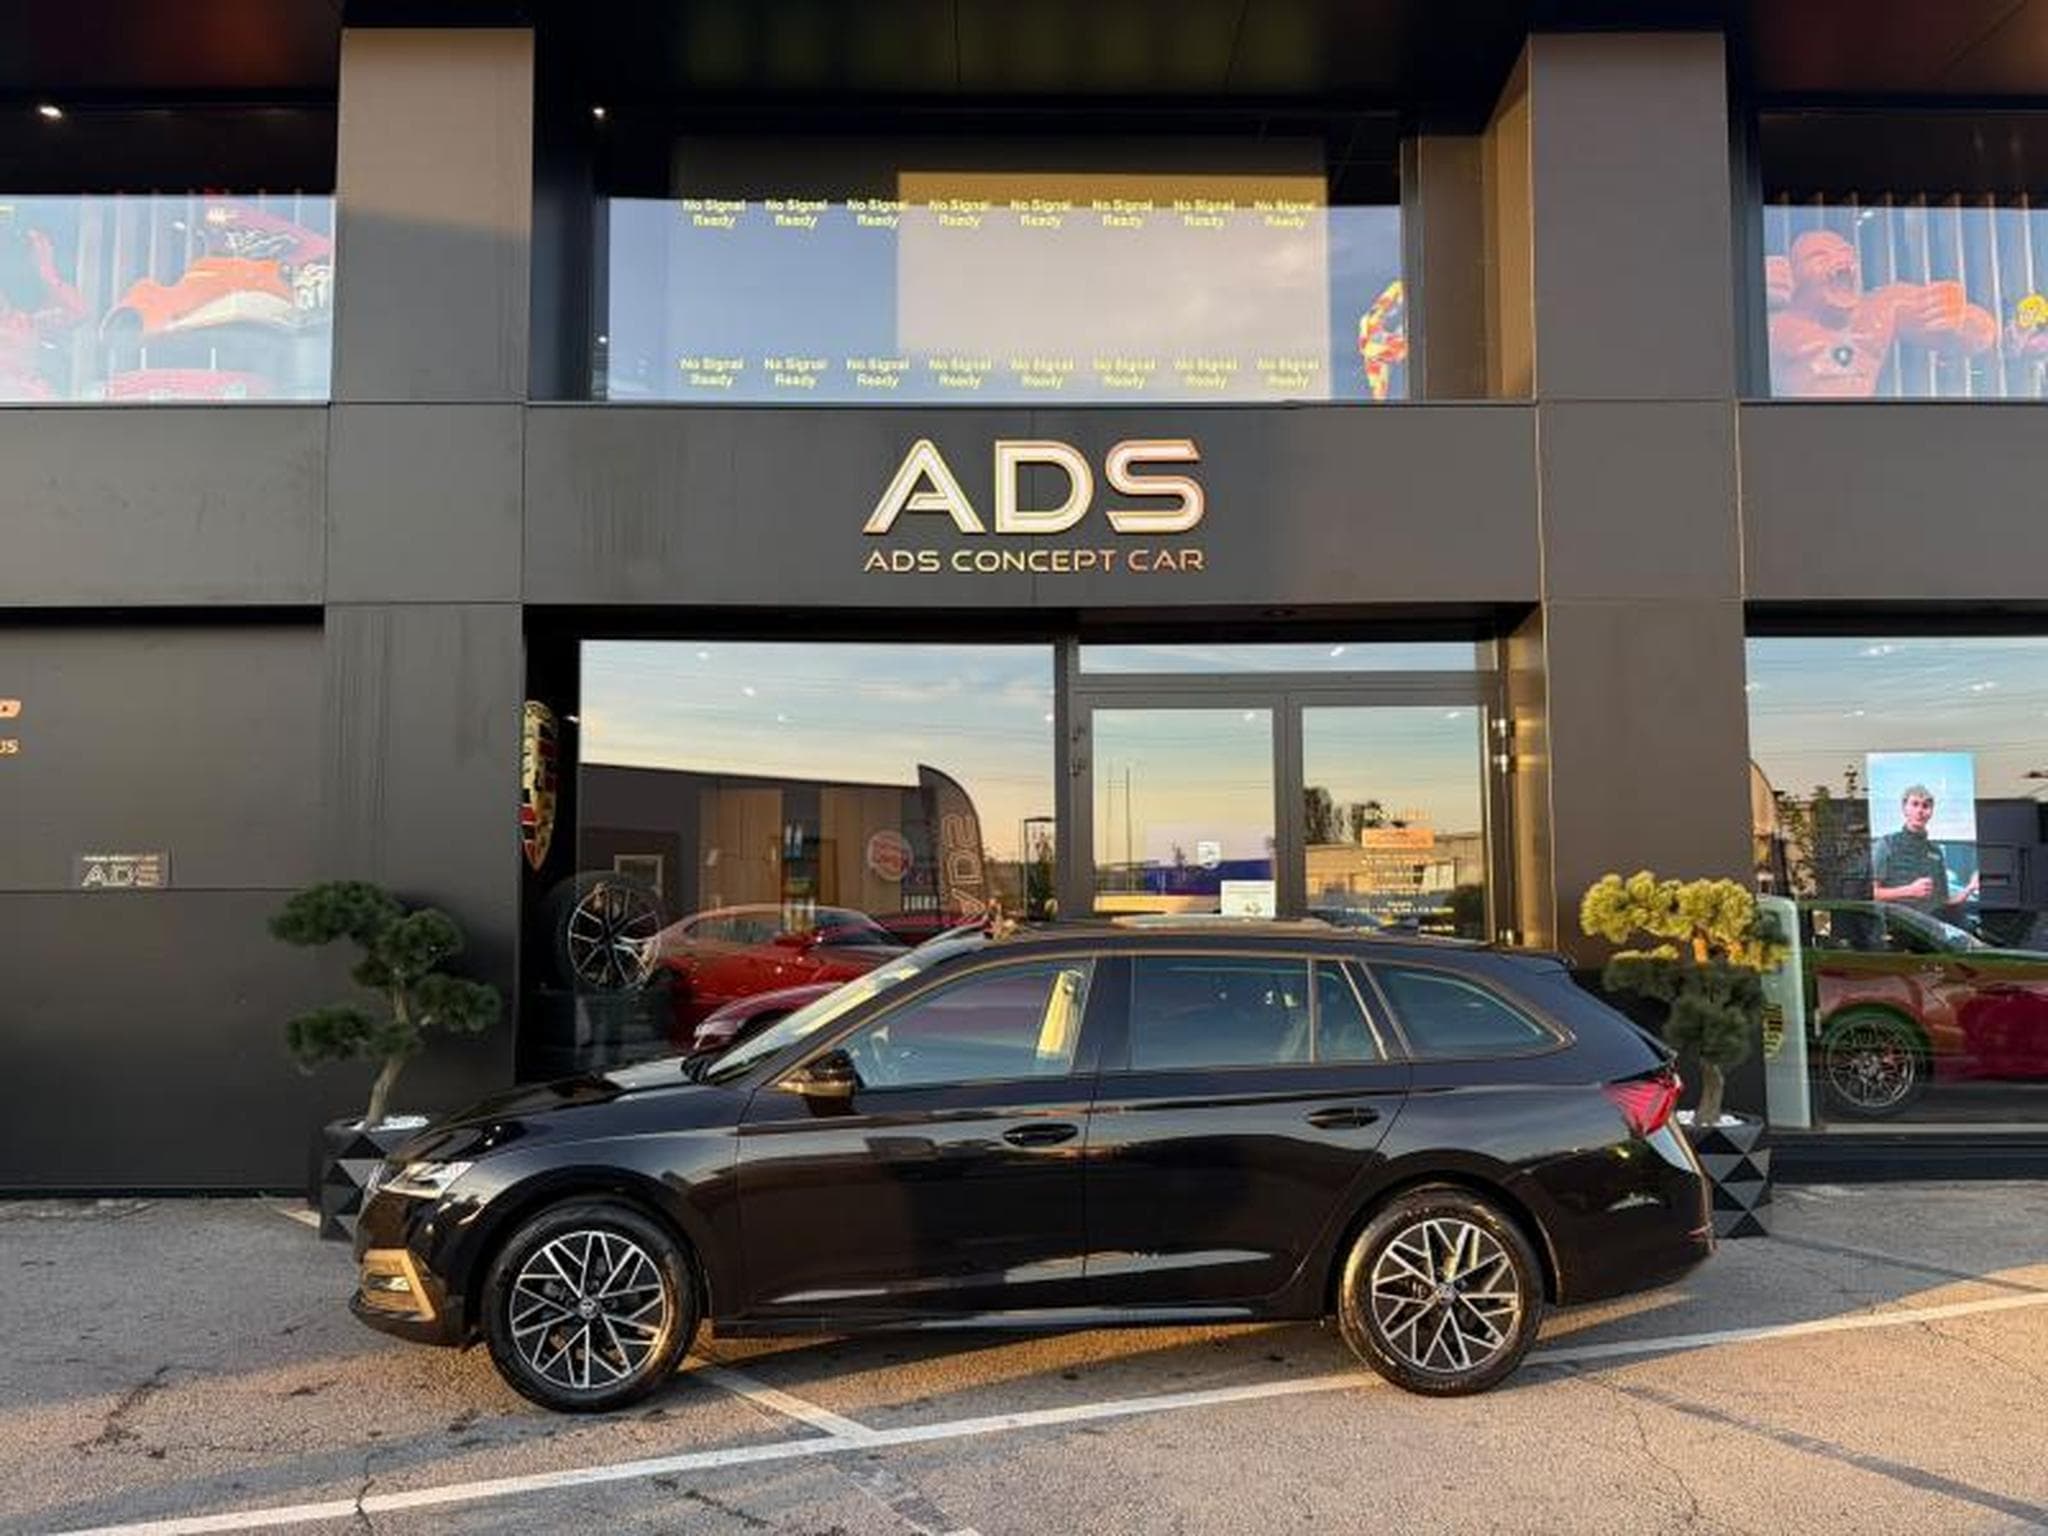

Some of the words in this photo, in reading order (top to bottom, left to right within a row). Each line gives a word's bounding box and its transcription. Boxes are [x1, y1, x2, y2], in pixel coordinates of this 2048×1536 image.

[683, 200, 701, 211] No
[705, 200, 746, 213] Signal
[765, 200, 784, 211] No
[787, 200, 828, 213] Signal
[847, 200, 866, 211] No
[869, 200, 909, 213] Signal
[929, 200, 947, 211] No
[951, 200, 991, 213] Signal
[1011, 200, 1030, 211] No
[1032, 200, 1072, 213] Signal
[1092, 200, 1111, 211] No
[1114, 200, 1153, 213] Signal
[1174, 200, 1192, 211] No
[1195, 200, 1235, 213] Signal
[1254, 200, 1274, 211] No
[1276, 200, 1316, 213] Signal
[862, 438, 1204, 534] ADS
[864, 550, 941, 572] ADS
[951, 550, 1116, 572] CONCEPT
[1128, 550, 1204, 572] CAR
